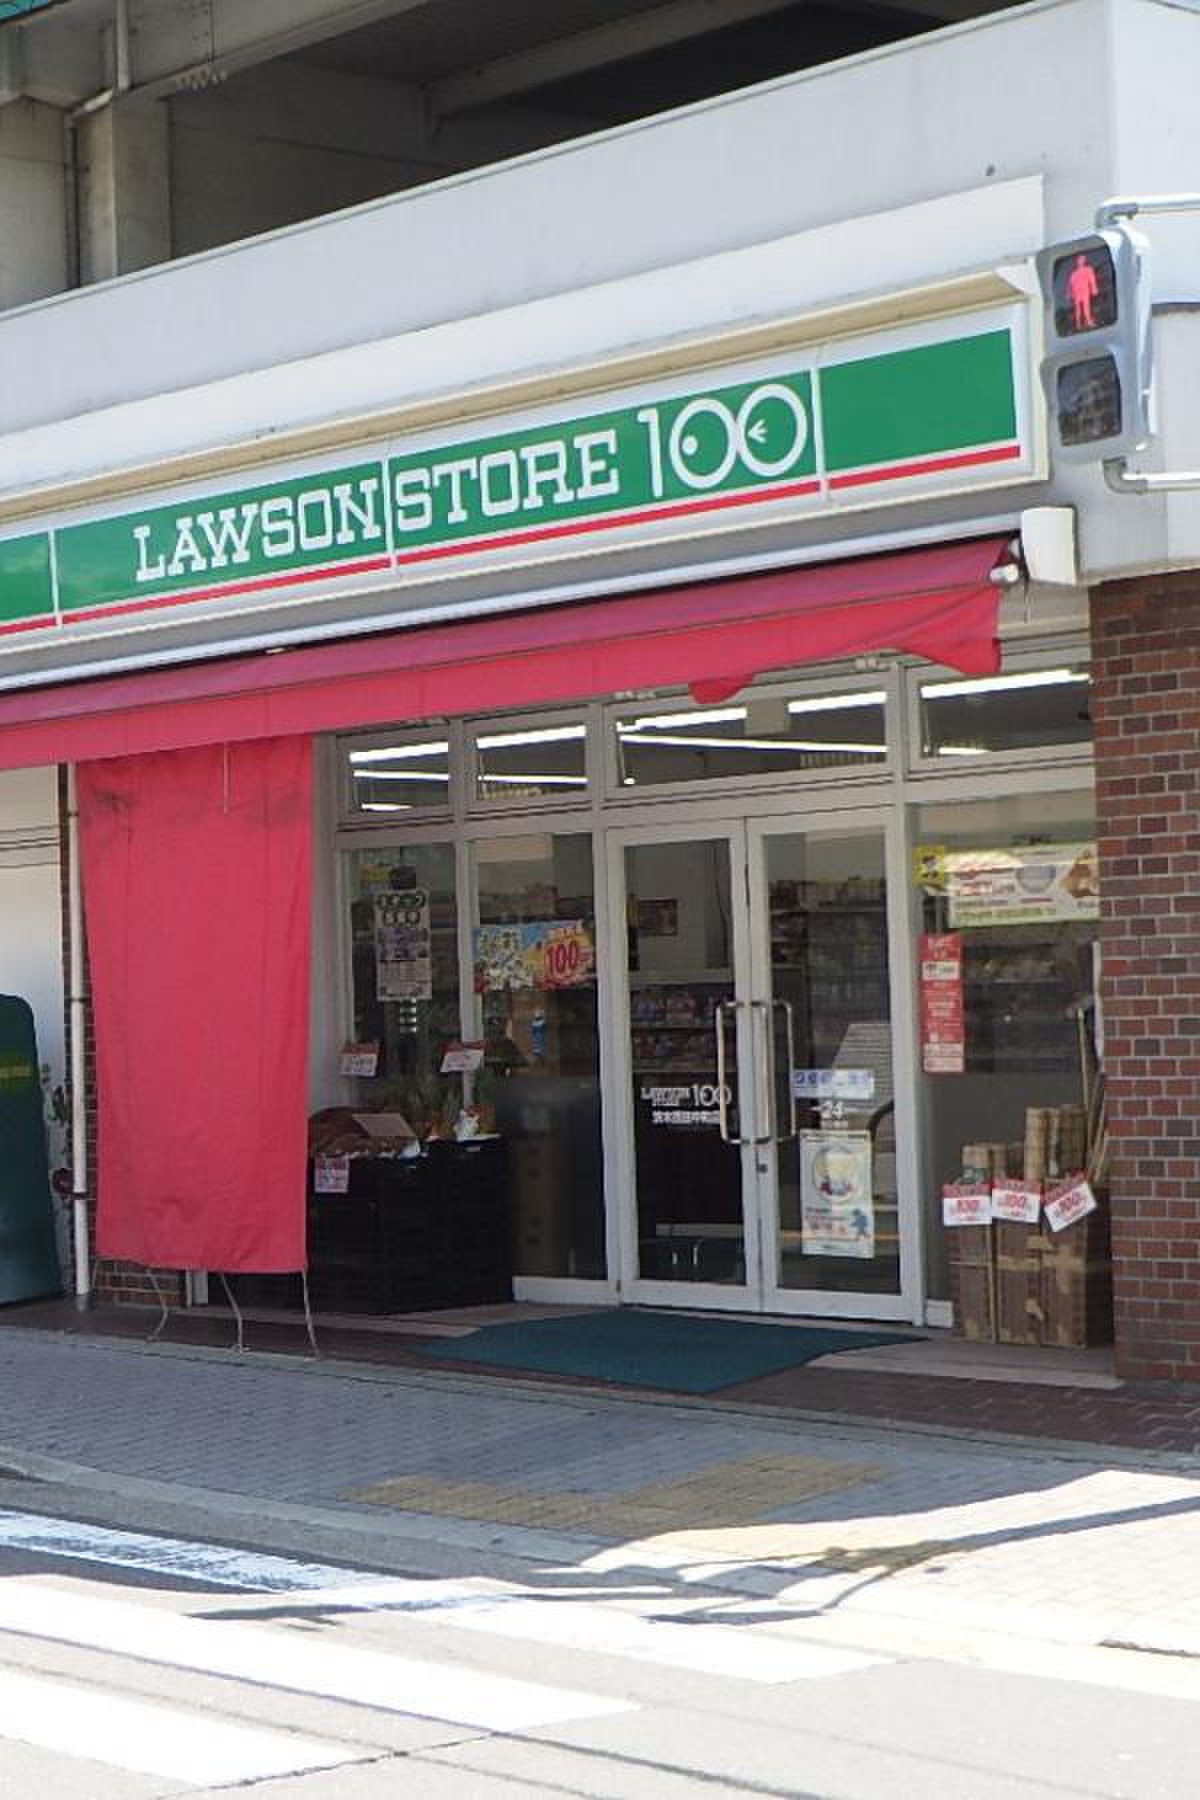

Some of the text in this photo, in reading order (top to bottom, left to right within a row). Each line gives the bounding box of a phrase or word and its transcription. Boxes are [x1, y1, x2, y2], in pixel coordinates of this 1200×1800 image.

[134, 384, 807, 581] LAWSON STORE 100
